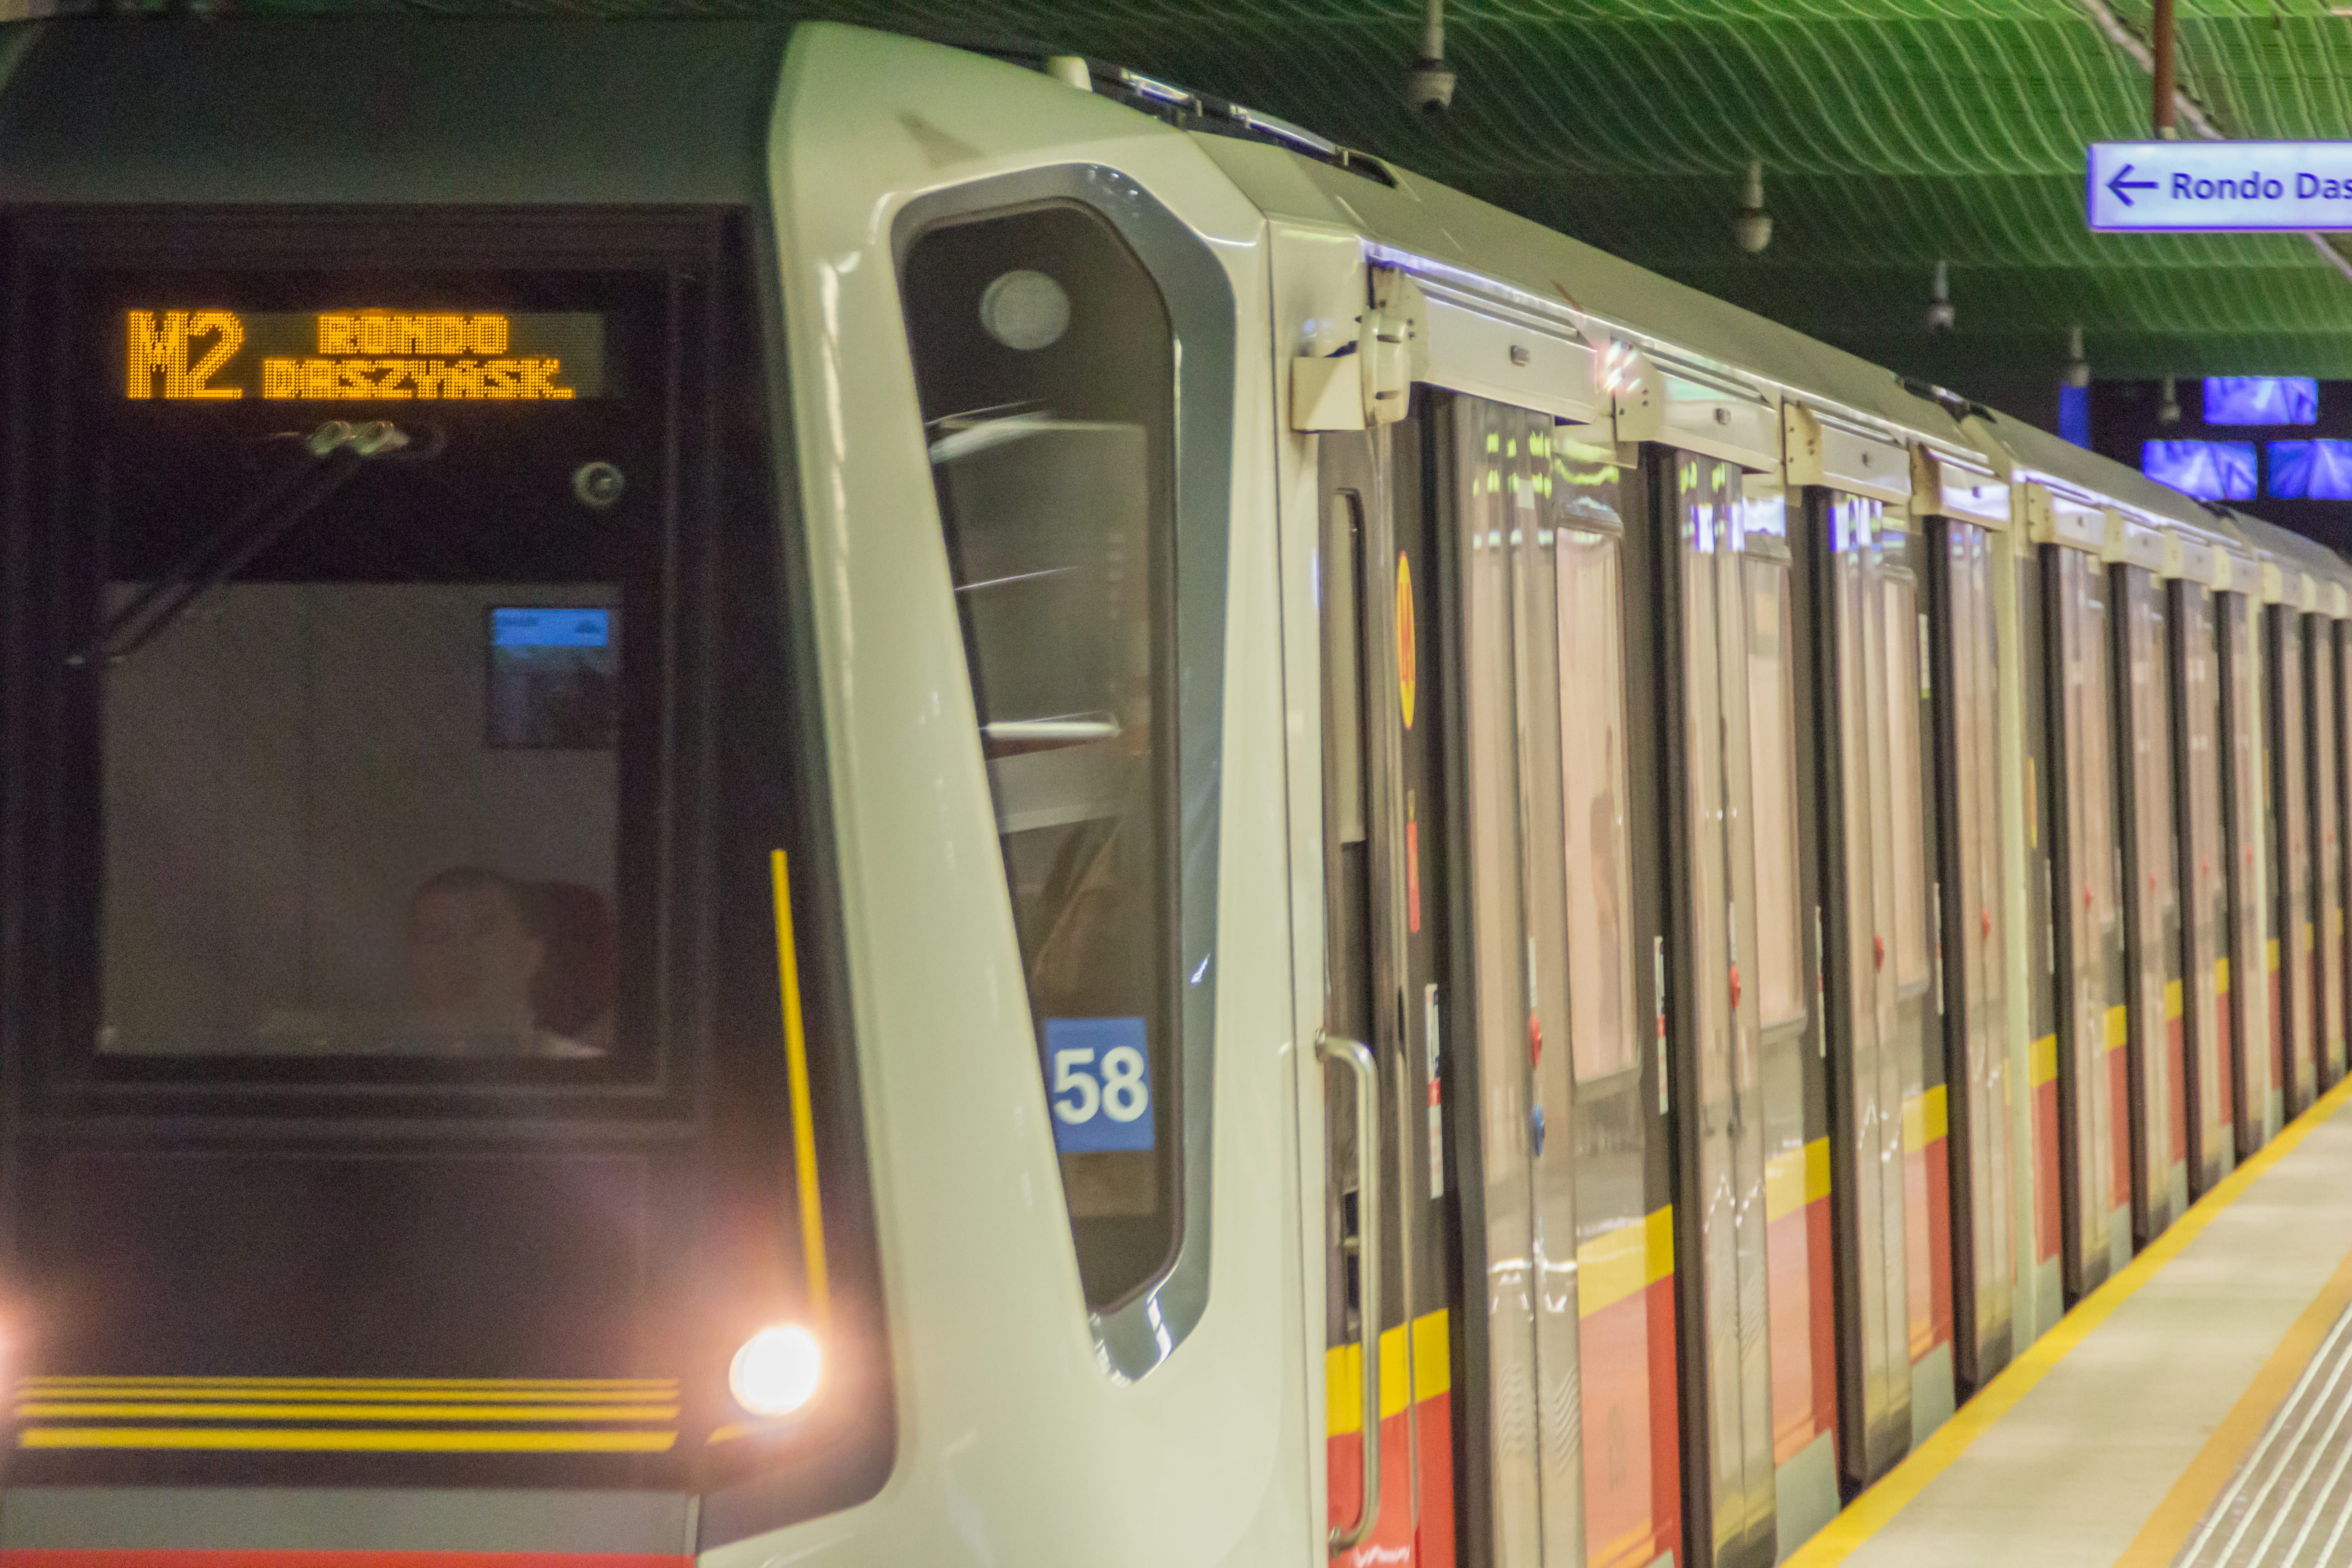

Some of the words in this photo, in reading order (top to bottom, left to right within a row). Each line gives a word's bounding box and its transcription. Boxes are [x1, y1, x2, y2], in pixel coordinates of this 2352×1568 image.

[2171, 171, 2284, 200] Rondo
[128, 310, 243, 399] M2
[319, 314, 509, 354] RONDO
[1054, 1046, 1149, 1125] 58
